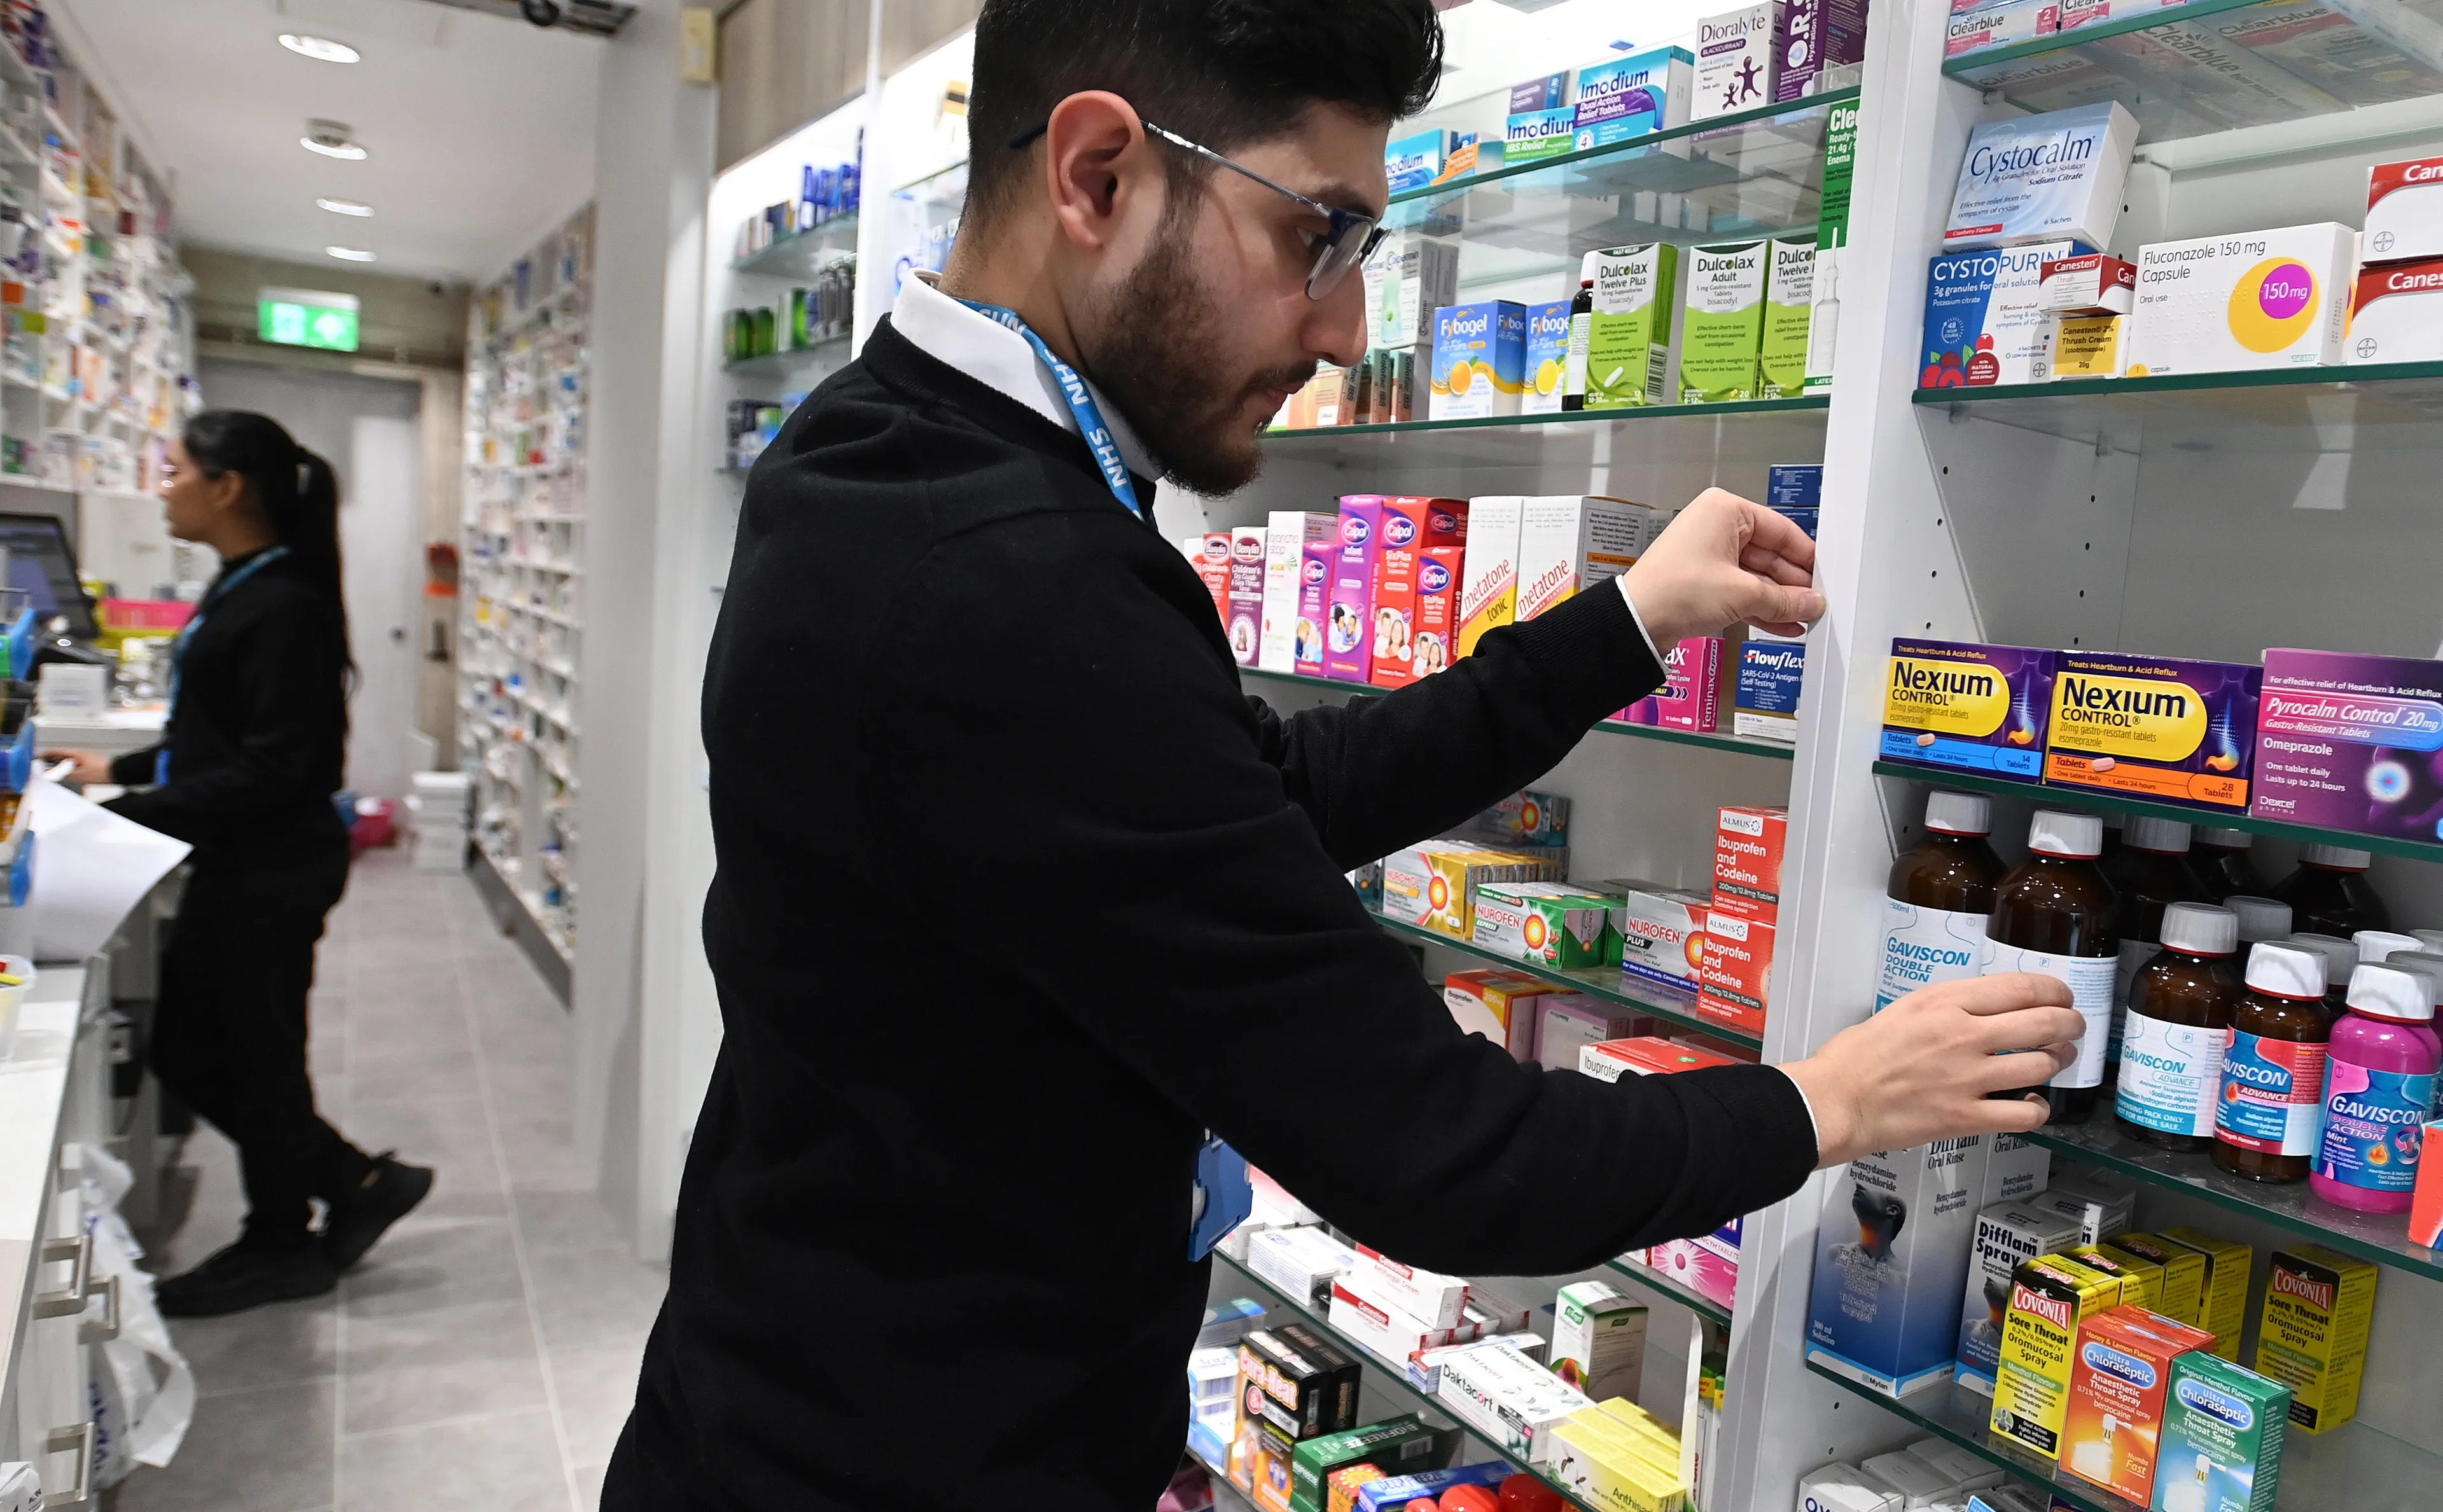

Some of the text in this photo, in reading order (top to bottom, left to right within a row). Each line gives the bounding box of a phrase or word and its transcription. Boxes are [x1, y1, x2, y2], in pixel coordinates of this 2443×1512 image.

[2043, 9, 2051, 20] 2
[1700, 10, 1766, 43] Dioralyte
[1951, 15, 2004, 37] Clearblue
[1581, 71, 1649, 99] Imodium
[1506, 139, 1547, 152] IBS Relief
[1971, 130, 2092, 184] Cystocalm
[2042, 165, 2057, 174] Oral
[2059, 162, 2085, 172] Solution
[2028, 173, 2084, 186] Sodium Citrate
[2050, 216, 2072, 225] Sachets
[1778, 247, 1816, 265] Dulcol
[2144, 240, 2266, 266] Fluconazole 150 mg
[1600, 262, 1647, 279] Dulcolax
[1697, 256, 1754, 272] Dulcolax
[1778, 266, 1809, 277] Twelve
[2054, 259, 2096, 272] Canesten
[1600, 277, 1646, 290] Twelve Plus
[1711, 274, 1737, 282] Adult
[2142, 265, 2191, 285] Capsule
[2388, 272, 2443, 290] Canes
[1934, 277, 2040, 297] 3g granules for oral solutio
[1707, 297, 1737, 305] bisacodyl
[1932, 298, 1960, 307] Potassium
[2140, 294, 2168, 304] Oral use
[1441, 314, 1487, 339] Fybogel
[1089, 426, 1127, 488] NHS
[1344, 524, 1368, 536] Calpol
[1388, 524, 1412, 536] Calpol
[1423, 573, 1446, 584] Calpol
[1463, 559, 1510, 611] metatone
[1518, 559, 1570, 615] metatone
[1487, 597, 1508, 622] tonic
[1744, 649, 1804, 670] Flowflex
[2068, 660, 2089, 669] Treats
[2091, 662, 2127, 672] Heartburn
[2136, 666, 2152, 674] Acid
[2154, 668, 2178, 677] Reflux
[1741, 678, 1776, 689] (Self-Testing)
[1742, 669, 1799, 683] SARS-CoV-2 Antigen
[1893, 661, 1993, 697] Nexium
[2283, 677, 2315, 687] effective
[2348, 683, 2387, 693] Heartburn
[2397, 687, 2414, 695] Acid
[2416, 690, 2442, 698] Reflux
[1702, 677, 1715, 728] Feminax
[2063, 677, 2186, 718] Nexium
[2267, 697, 2336, 718] Pyrocalm
[2341, 704, 2402, 724] Control
[2081, 726, 2132, 740] gastro-resistant
[2133, 733, 2157, 742] tablets
[2266, 719, 2371, 738] Gastro-Resistant Tablets
[2059, 735, 2102, 748] esomeprazole
[2264, 737, 2333, 756] Omeprazole
[2007, 760, 2030, 770] Tablets
[2056, 757, 2087, 768] Tablets
[2266, 762, 2330, 778] One tablet daily
[2222, 782, 2234, 791] 28
[2266, 774, 2285, 784] Lasts
[2287, 779, 2297, 787] up
[2322, 781, 2346, 791] hours
[2204, 788, 2233, 799] Tablets
[1723, 817, 1750, 828] ALMUS
[1718, 835, 1766, 857] Ibuprofen
[1717, 854, 1736, 865] and
[1716, 864, 1758, 884] Codeine
[1477, 905, 1521, 929] NUROFEN
[1709, 920, 1736, 933] ALMUS
[1629, 917, 1681, 946] NUROFEN
[1627, 936, 1645, 947] PLUS
[1704, 938, 1751, 962] Ibuprofen
[1887, 936, 1970, 966] GAVISCON
[1702, 955, 1722, 968] and
[1886, 954, 1935, 974] DOUBLE
[1702, 966, 1742, 988] Codeine
[1884, 965, 1930, 983] ACTION
[2124, 1045, 2186, 1073] GAVISCON
[2159, 1074, 2195, 1086] ADVANCE
[2224, 1058, 2289, 1086] AVISCON
[2241, 1087, 2288, 1102] ADVANCE
[2145, 1110, 2184, 1123] PACK ONLY.
[2332, 1095, 2426, 1125] GAVISCON
[2126, 1111, 2180, 1130] FOR RETAIL SALE.
[2332, 1114, 2389, 1133] DOUBLE
[2327, 1131, 2348, 1144] Mint
[2330, 1124, 2385, 1142] ACTION
[1928, 1152, 1965, 1169] Oral Rinse
[1849, 1168, 1897, 1192] hydrochloride
[1979, 1221, 2036, 1256] Difflam
[1717, 1244, 1739, 1259] TABLETS
[2274, 1268, 2328, 1310] COVONIA
[2014, 1284, 2068, 1329] COVONIA
[2268, 1294, 2329, 1326] Sore Throat
[2008, 1312, 2068, 1346] Sore Throat
[2268, 1314, 2325, 1342] Oromucosal
[2008, 1332, 2064, 1364] Oromucosal
[2086, 1331, 2105, 1344] Honey
[2112, 1341, 2133, 1354] Lemon
[2133, 1348, 2157, 1363] Flavour
[2280, 1329, 2307, 1348] Spray
[2020, 1349, 2047, 1369] Spray
[2086, 1349, 2151, 1384] Chloraseptic
[2107, 1352, 2130, 1366] Ultra
[1443, 1363, 1494, 1413] Daktacort
[1869, 1377, 1888, 1391] Mylan
[2091, 1372, 2141, 1398] Anaesthetic
[2179, 1366, 2255, 1403] Original Menthol Flavour
[2089, 1380, 2141, 1408] Throat Spray
[2203, 1390, 2226, 1405] Ultra
[2094, 1399, 2131, 1421] benzocaine
[2180, 1387, 2247, 1424] Chloraseptic
[2183, 1418, 2236, 1450] Throat Spray
[2185, 1410, 2236, 1439] Anaesthetic
[2127, 1452, 2149, 1466] Numbs
[2187, 1439, 2226, 1463] benzocaine
[2125, 1459, 2147, 1476] Fast
[1613, 1487, 1653, 1512] Anthisa
